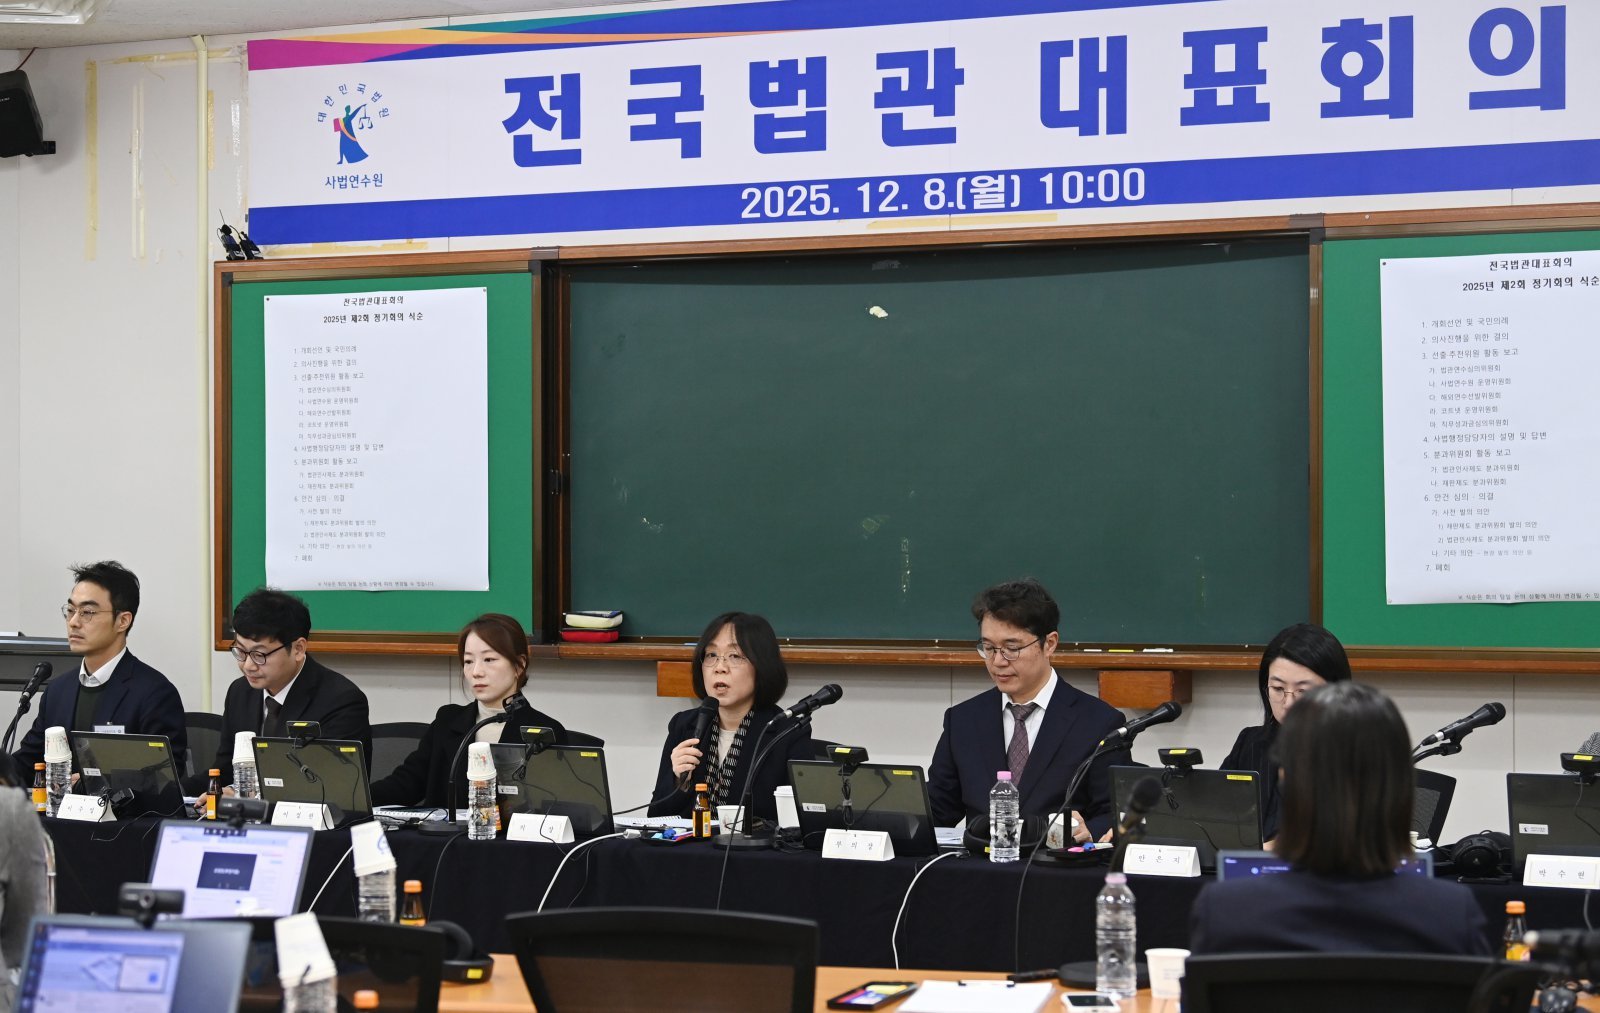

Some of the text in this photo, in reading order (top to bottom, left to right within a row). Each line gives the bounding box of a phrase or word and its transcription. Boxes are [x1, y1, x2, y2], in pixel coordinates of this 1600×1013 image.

[502, 5, 1566, 168] 전국법관 대표회의
[325, 173, 383, 189] 사법연수원
[741, 184, 840, 219] 2025.
[857, 180, 908, 214] 12.
[1040, 168, 1146, 204] 10:00
[1490, 257, 1572, 271] 전국법관대표회의
[1463, 276, 1600, 291] 2025년 제2회 정기회의 식순
[344, 296, 404, 306] 전국법관대표회의
[324, 312, 423, 323] 2025년 제2회 정기회의 식순
